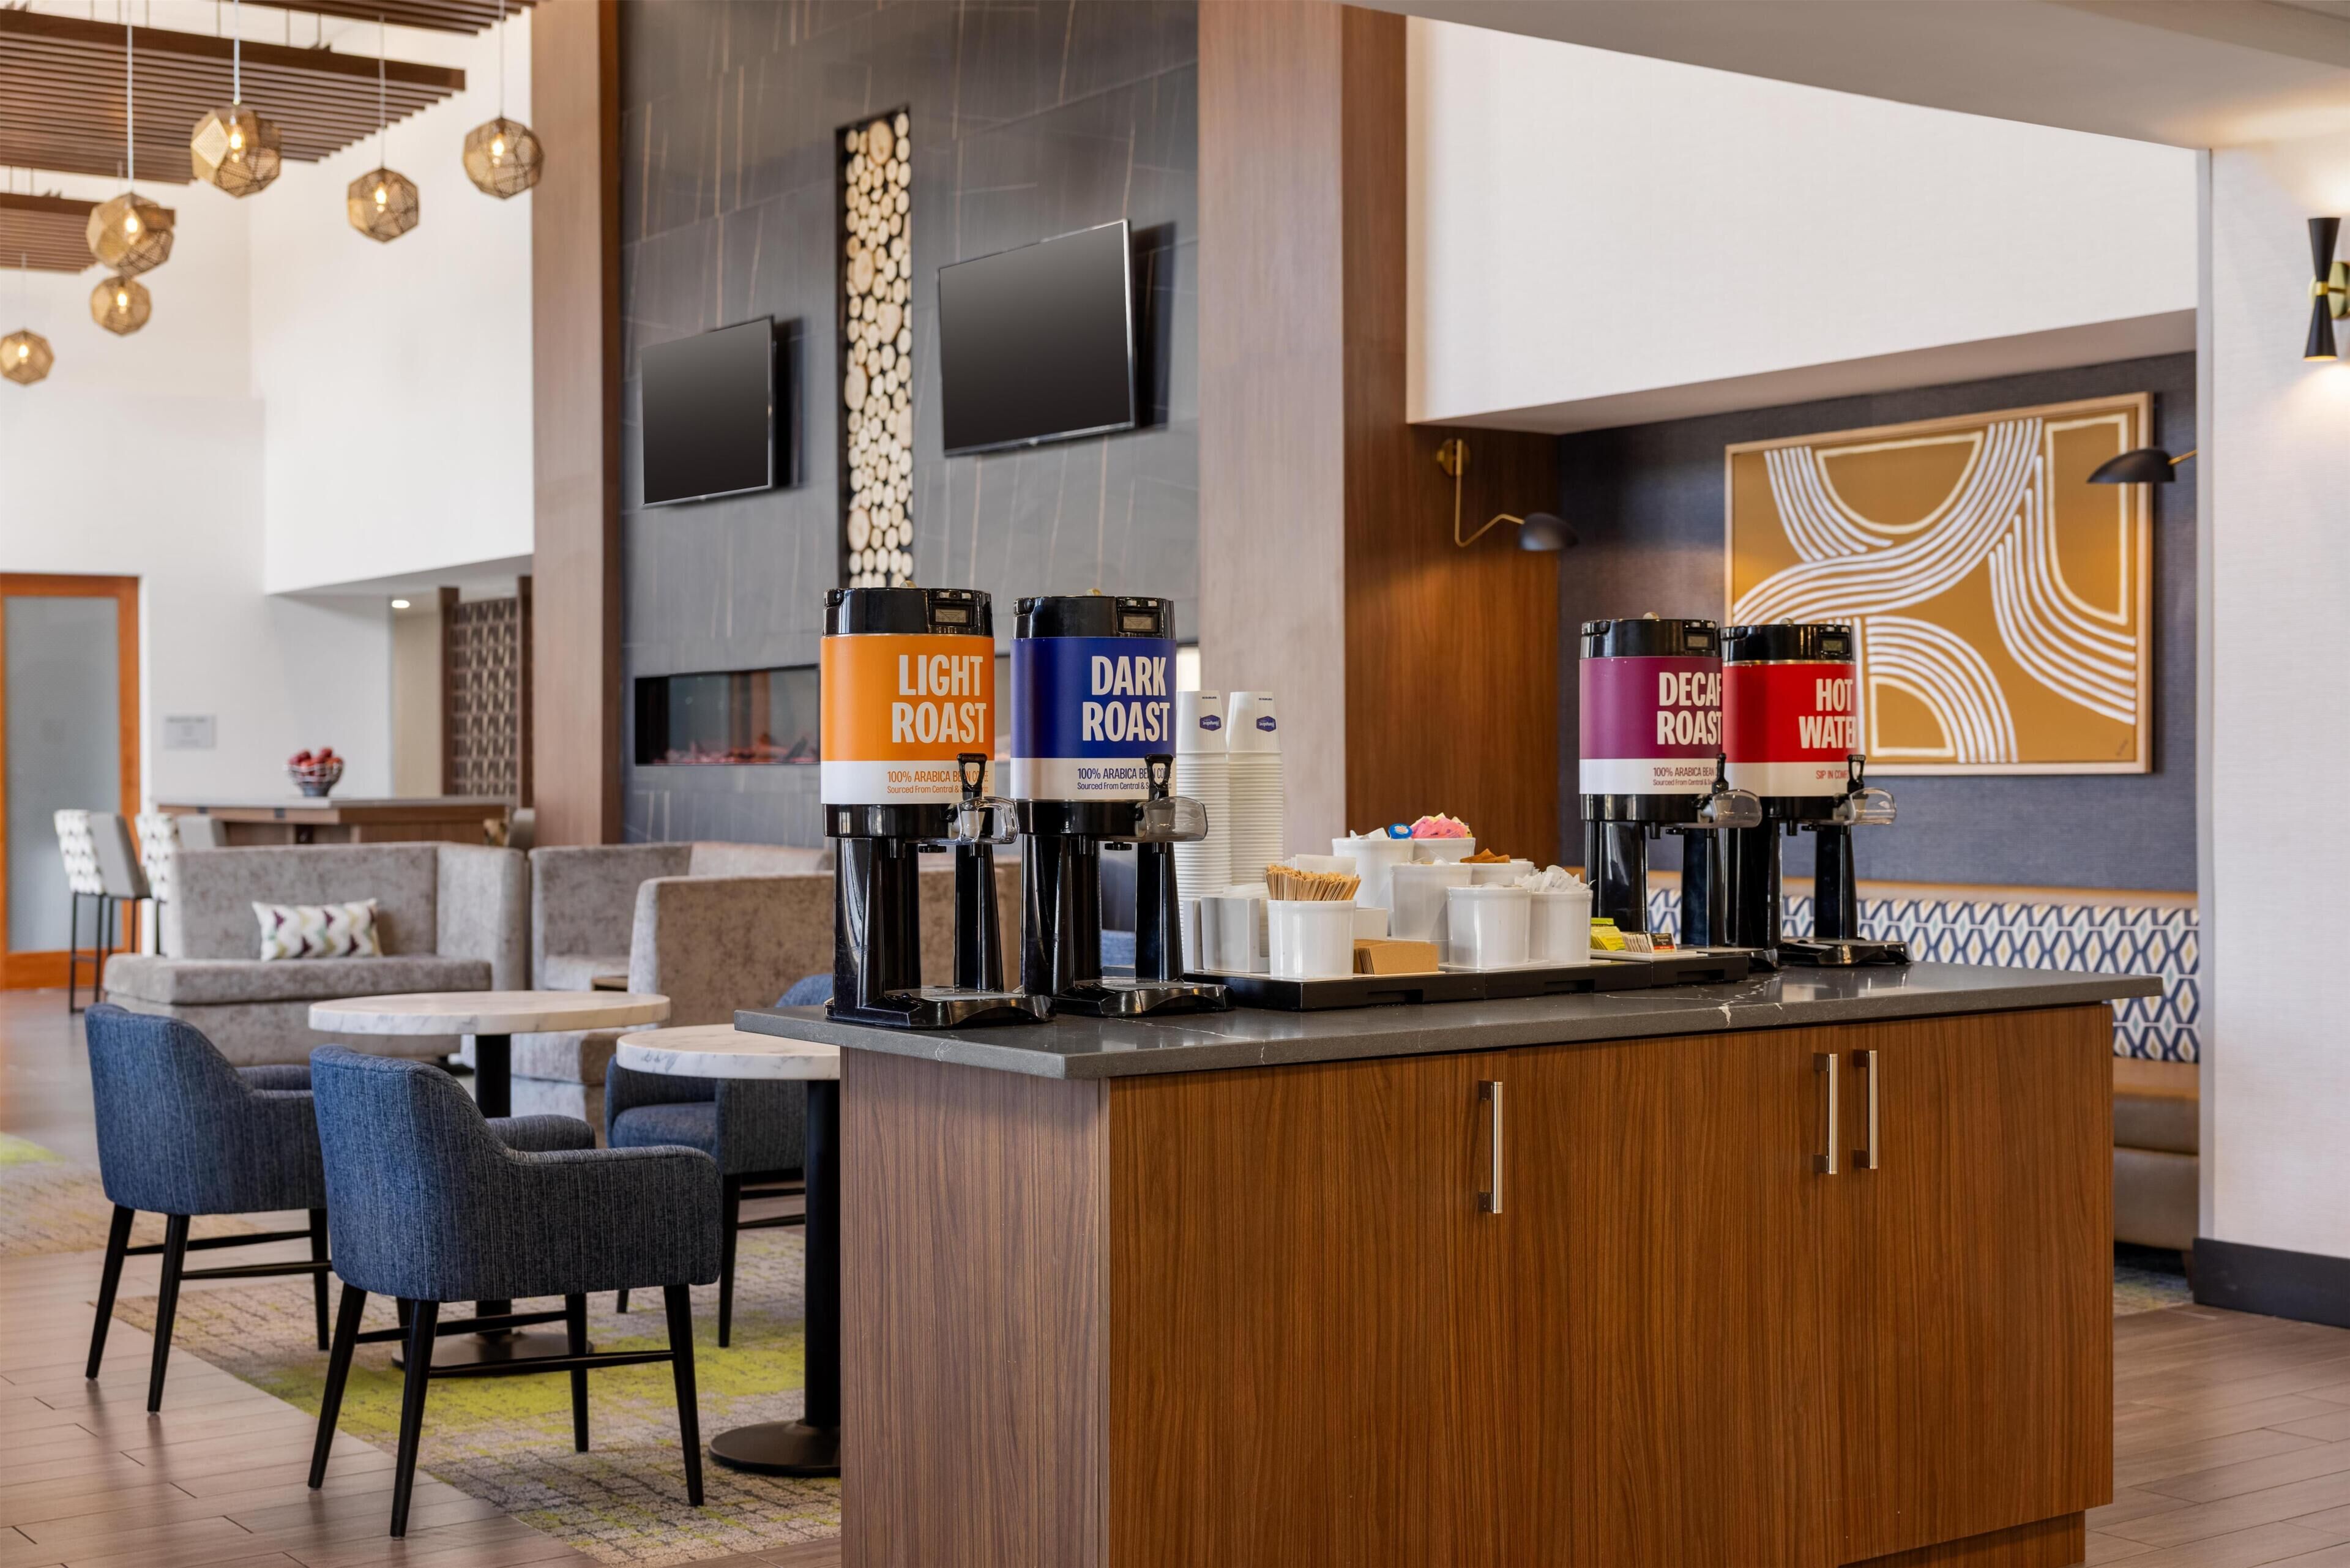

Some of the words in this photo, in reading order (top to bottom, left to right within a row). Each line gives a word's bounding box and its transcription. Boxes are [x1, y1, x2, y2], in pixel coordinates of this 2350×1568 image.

[899, 654, 983, 696] LIGHT
[1091, 655, 1166, 696] DARK
[1659, 671, 1721, 707] DECAF
[1816, 678, 1853, 712] HOT
[892, 701, 987, 744] ROAST
[1082, 701, 1170, 742] ROAST
[1657, 710, 1722, 745] ROAST
[887, 771, 912, 783] 100%
[914, 770, 950, 782] ARABICA
[953, 771, 971, 782] BEN
[1077, 768, 1101, 779] 100%
[1103, 767, 1137, 779] ARABICA
[1653, 767, 1673, 777] 100%
[1674, 767, 1701, 776] ARABICA
[1816, 769, 1826, 779] SIP
[1827, 770, 1833, 779] IN
[887, 785, 914, 794] Sourced
[915, 785, 931, 794] From
[932, 785, 953, 793] Central
